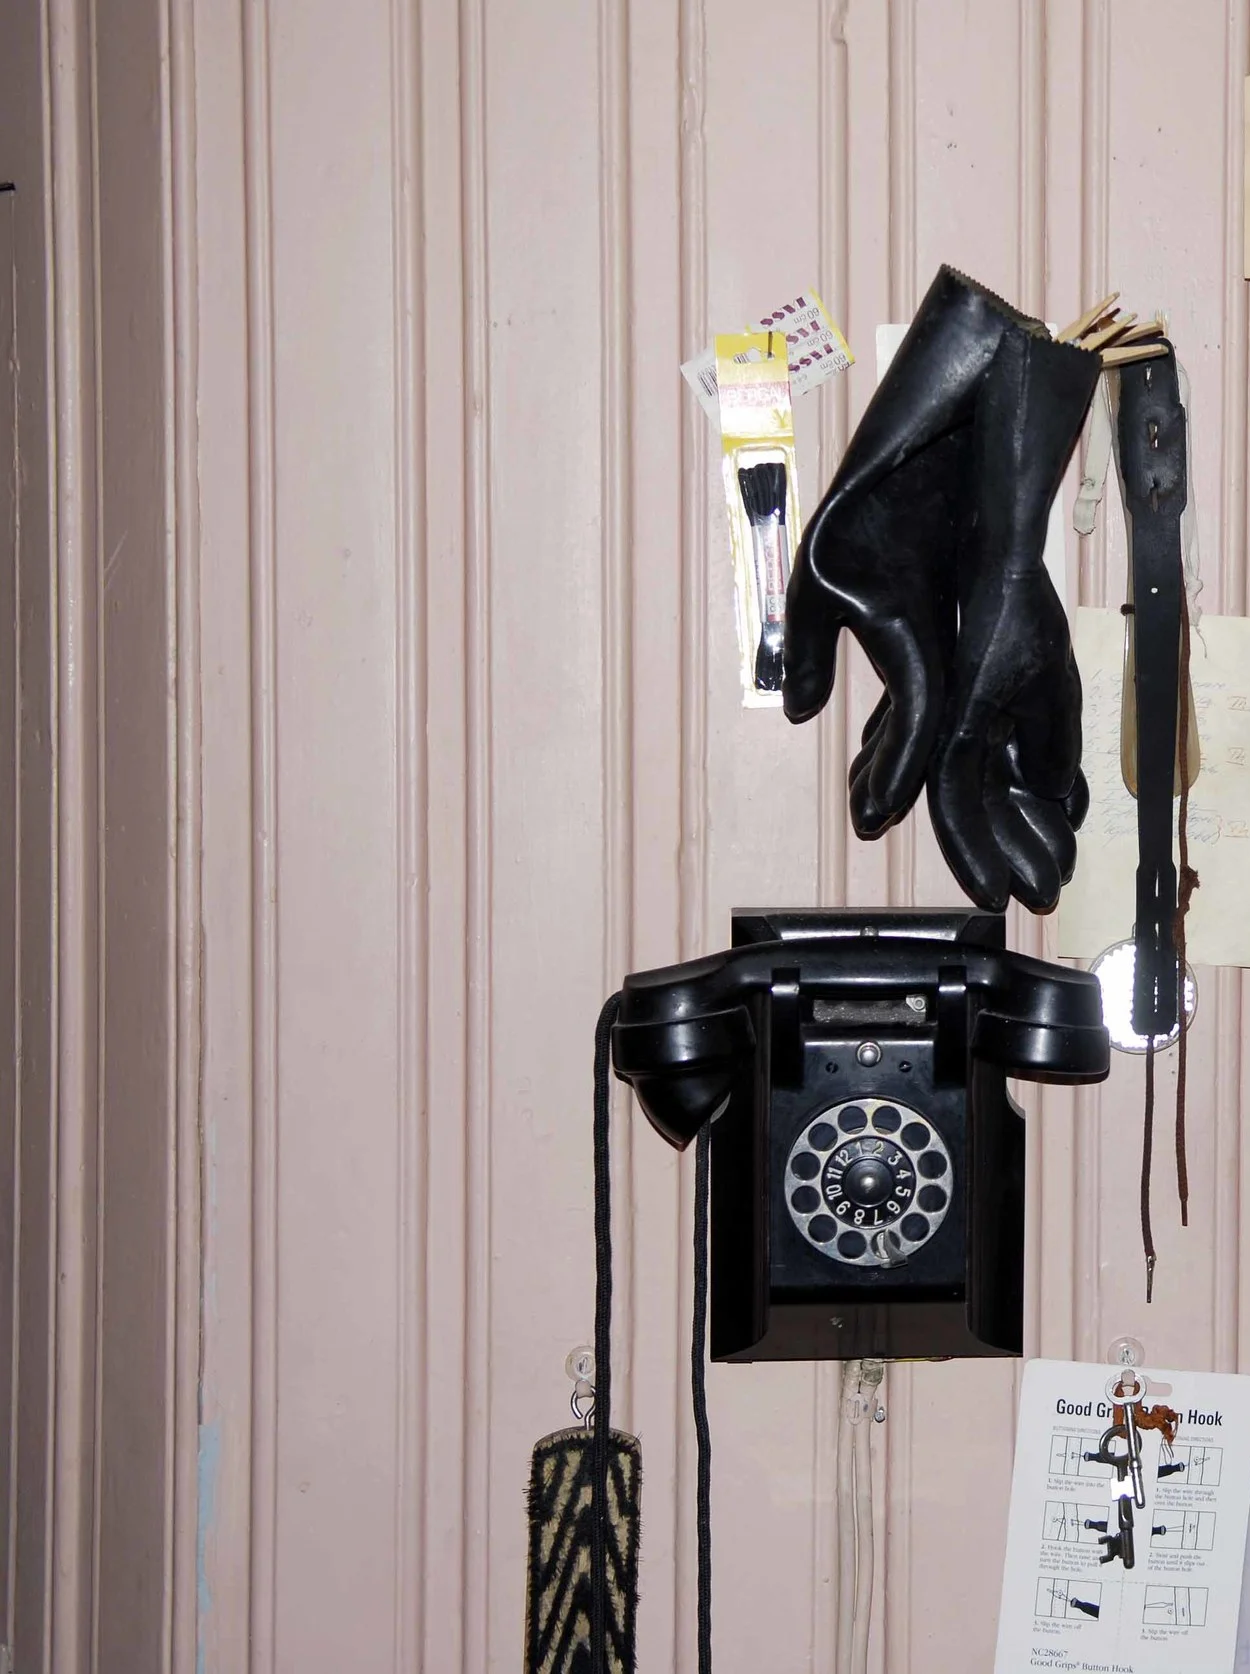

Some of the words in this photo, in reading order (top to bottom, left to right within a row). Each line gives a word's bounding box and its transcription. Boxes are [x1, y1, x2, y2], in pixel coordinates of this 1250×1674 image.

[856, 1141, 864, 1156] 1
[871, 1141, 884, 1157] 2
[835, 1150, 854, 1167] 12
[887, 1151, 901, 1165] 3
[827, 1166, 843, 1180] 11
[897, 1169, 912, 1179] 4
[826, 1184, 843, 1200] 10
[896, 1186, 911, 1198] 5
[836, 1201, 850, 1215] 9
[887, 1200, 901, 1214] 6
[854, 1209, 866, 1225] 8
[873, 1209, 884, 1225] 7
[1056, 1398, 1092, 1417] Good
[1188, 1409, 1223, 1426] Hook
[1032, 1648, 1068, 1658] NC28667
[1030, 1658, 1052, 1667] Good
[1082, 1663, 1109, 1672] Button
[1112, 1664, 1134, 1674] Hook
